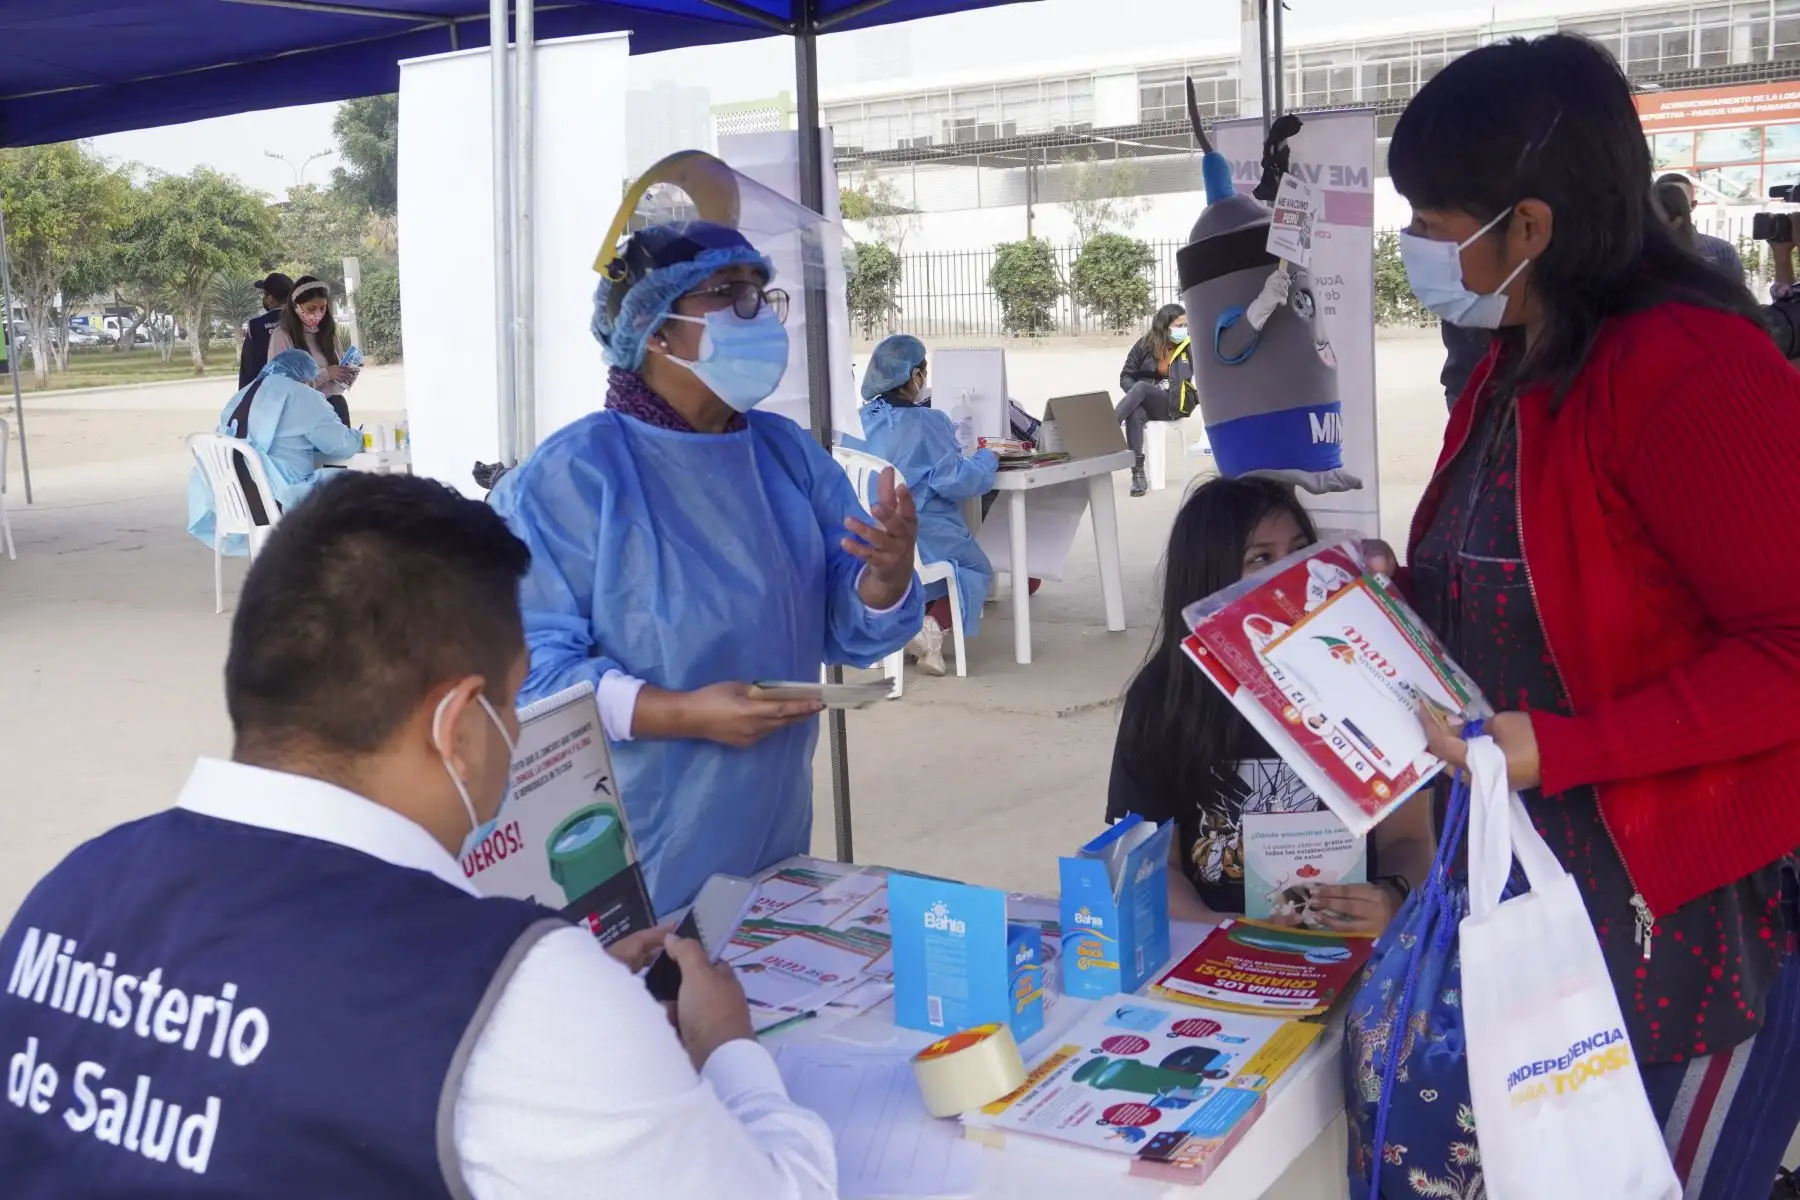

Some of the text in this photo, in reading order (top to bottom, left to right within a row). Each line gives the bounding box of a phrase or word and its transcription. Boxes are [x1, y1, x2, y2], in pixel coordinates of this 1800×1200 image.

[1753, 94, 1764, 102] DE
[1766, 93, 1778, 101] LA
[1342, 626, 1417, 700] se cura
[6, 926, 269, 1066] Ministerio
[1194, 964, 1318, 989] CRIADEROS!
[1214, 979, 1246, 991] LOS
[8, 1037, 221, 1174] de Salud
